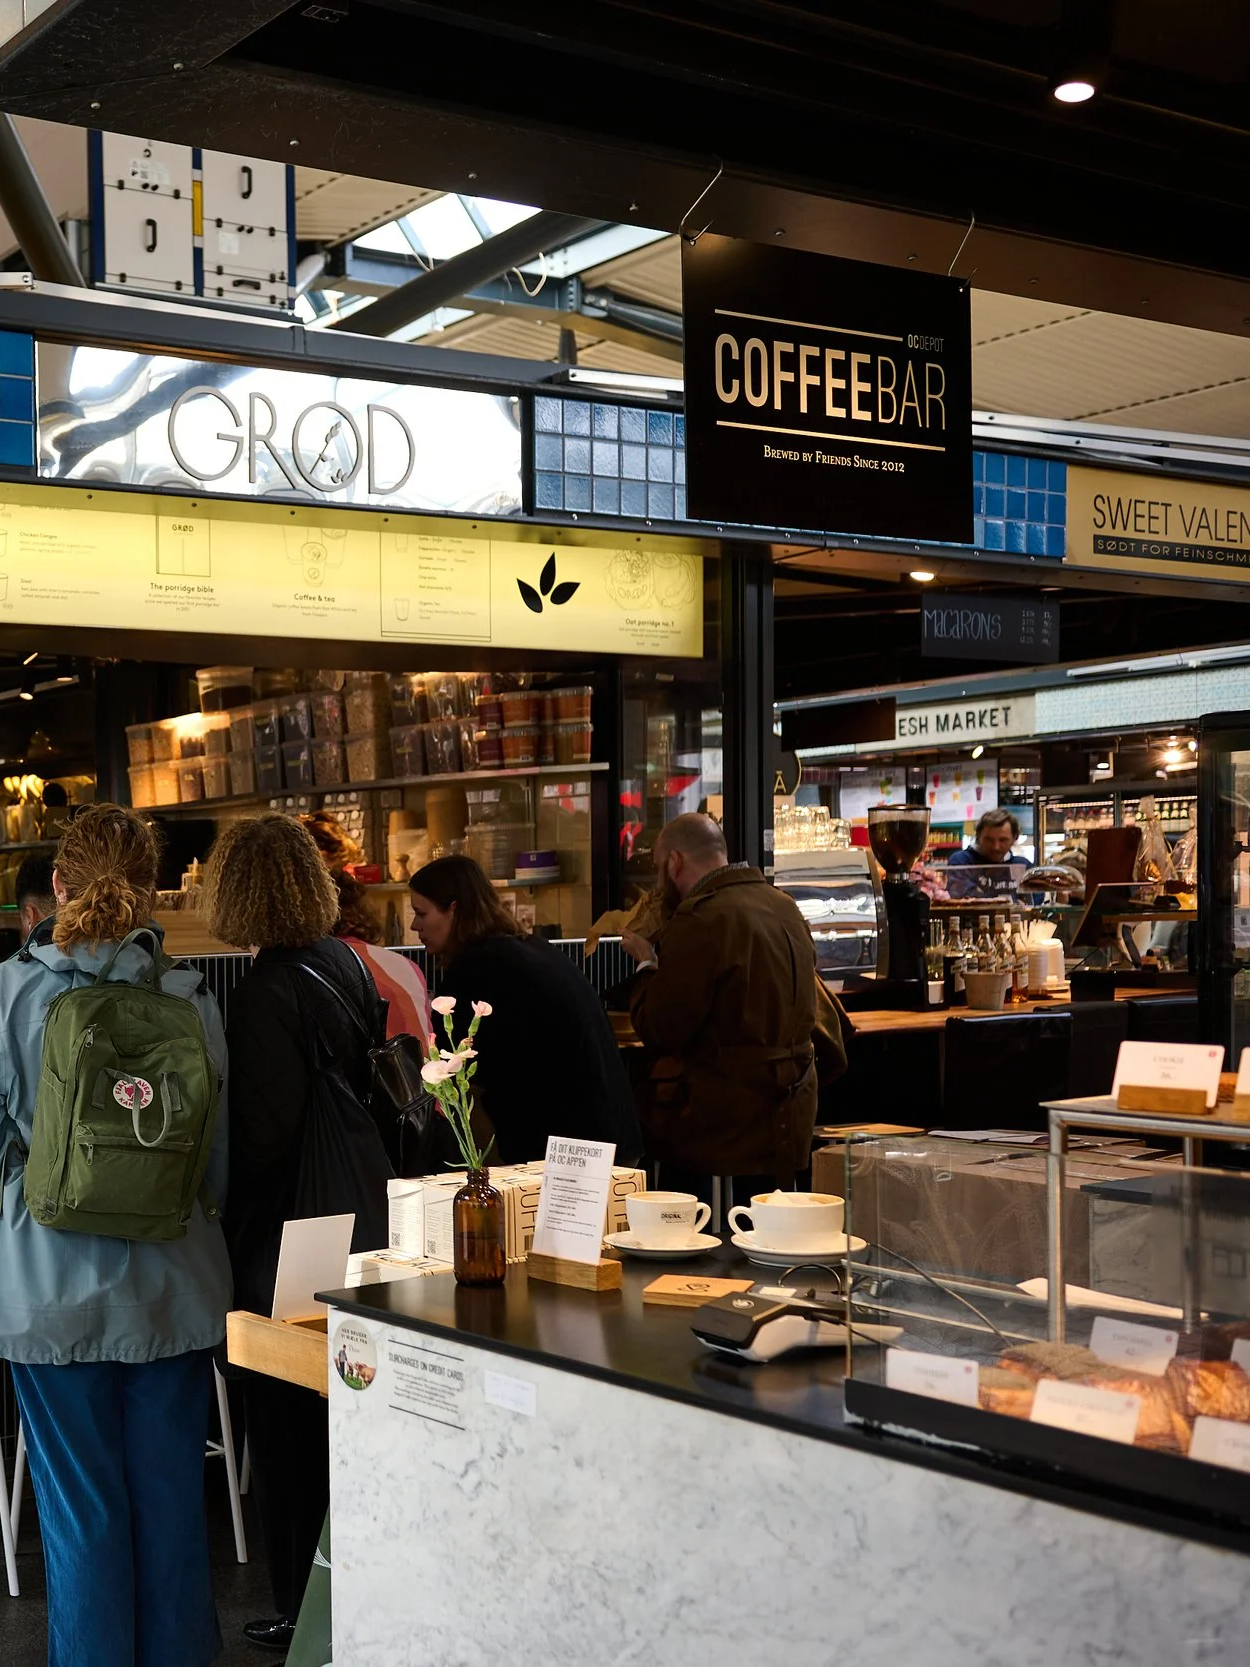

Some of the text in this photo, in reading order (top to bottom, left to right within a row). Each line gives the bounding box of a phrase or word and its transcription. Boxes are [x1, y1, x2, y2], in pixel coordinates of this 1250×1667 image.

[907, 334, 944, 353] OCDEPOT
[715, 333, 946, 430] COFFEEBAR
[881, 461, 905, 473] 2012
[1093, 494, 1172, 536] SWEET
[172, 524, 194, 532] GRØD
[1097, 539, 1250, 564] SØDT FOR FEINSCHM
[150, 582, 214, 594] The porridge bible
[294, 593, 316, 601] Coffee
[637, 619, 660, 628] porridge
[898, 706, 1011, 736] ESH MARKET
[548, 1152, 556, 1164] PÅ
[550, 1141, 603, 1158] FÅ DIT KLIPPEKORT
[388, 1352, 464, 1382] SURCHARGES ON CREDIT CARDS
